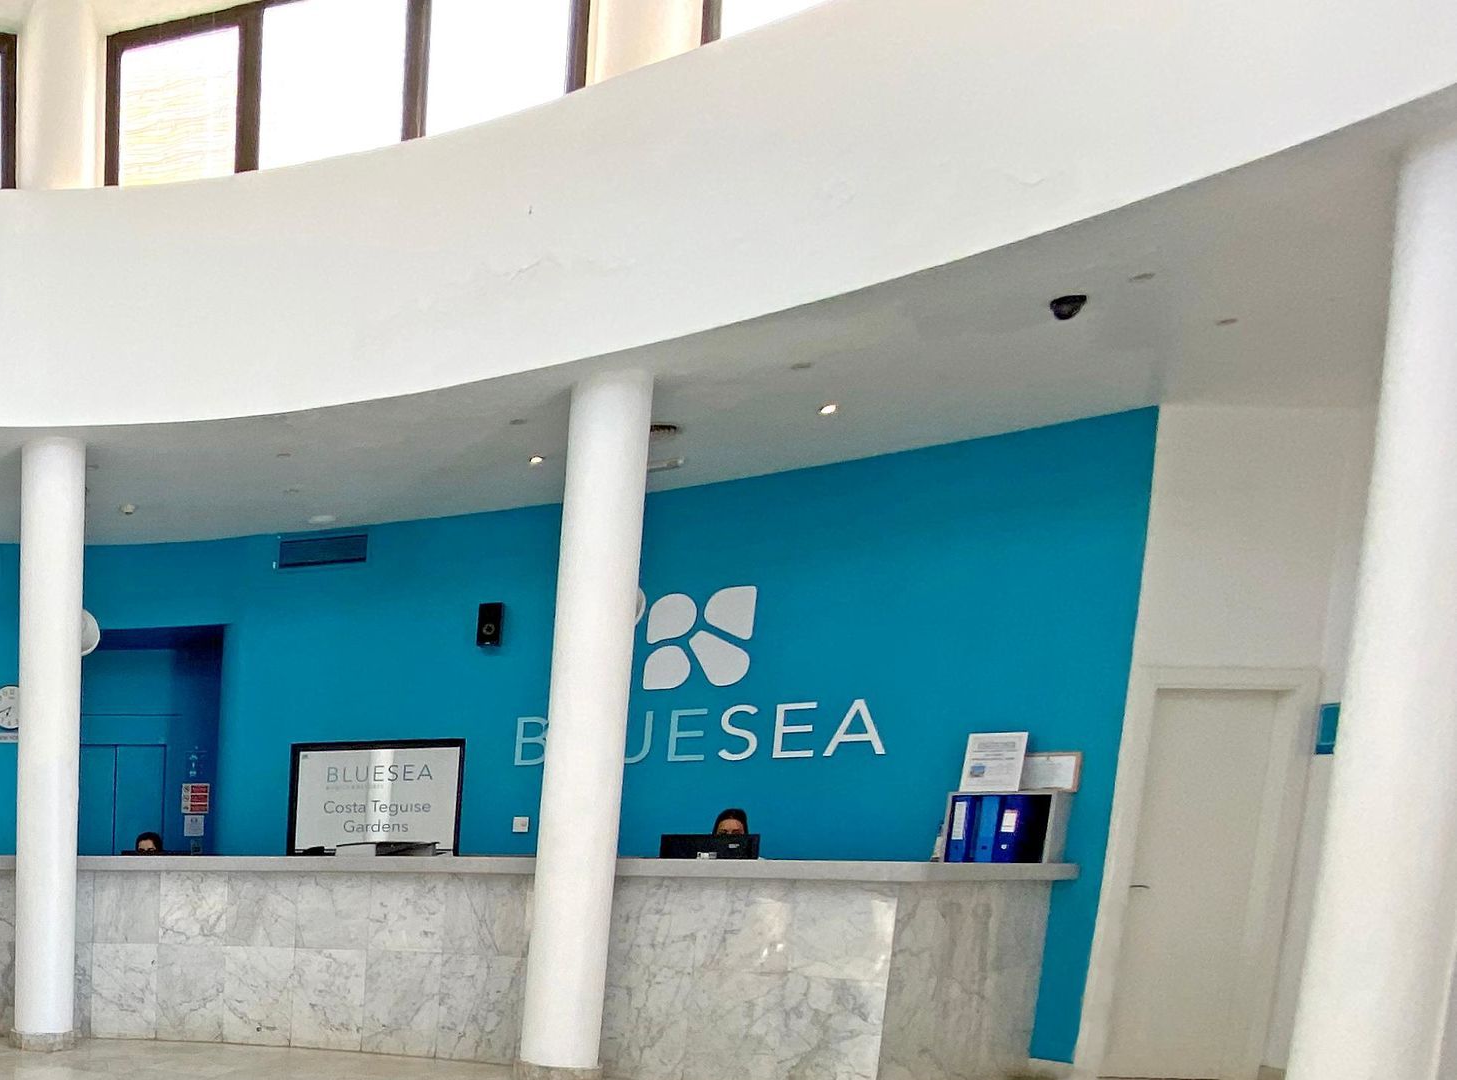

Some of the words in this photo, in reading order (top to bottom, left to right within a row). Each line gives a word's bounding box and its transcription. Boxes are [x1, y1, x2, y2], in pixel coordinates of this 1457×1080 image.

[514, 699, 886, 766] BUESEA
[327, 764, 433, 783] BLUESEA
[323, 801, 366, 814] Costa
[371, 800, 431, 816] Teguise
[343, 819, 409, 833] Gardens
